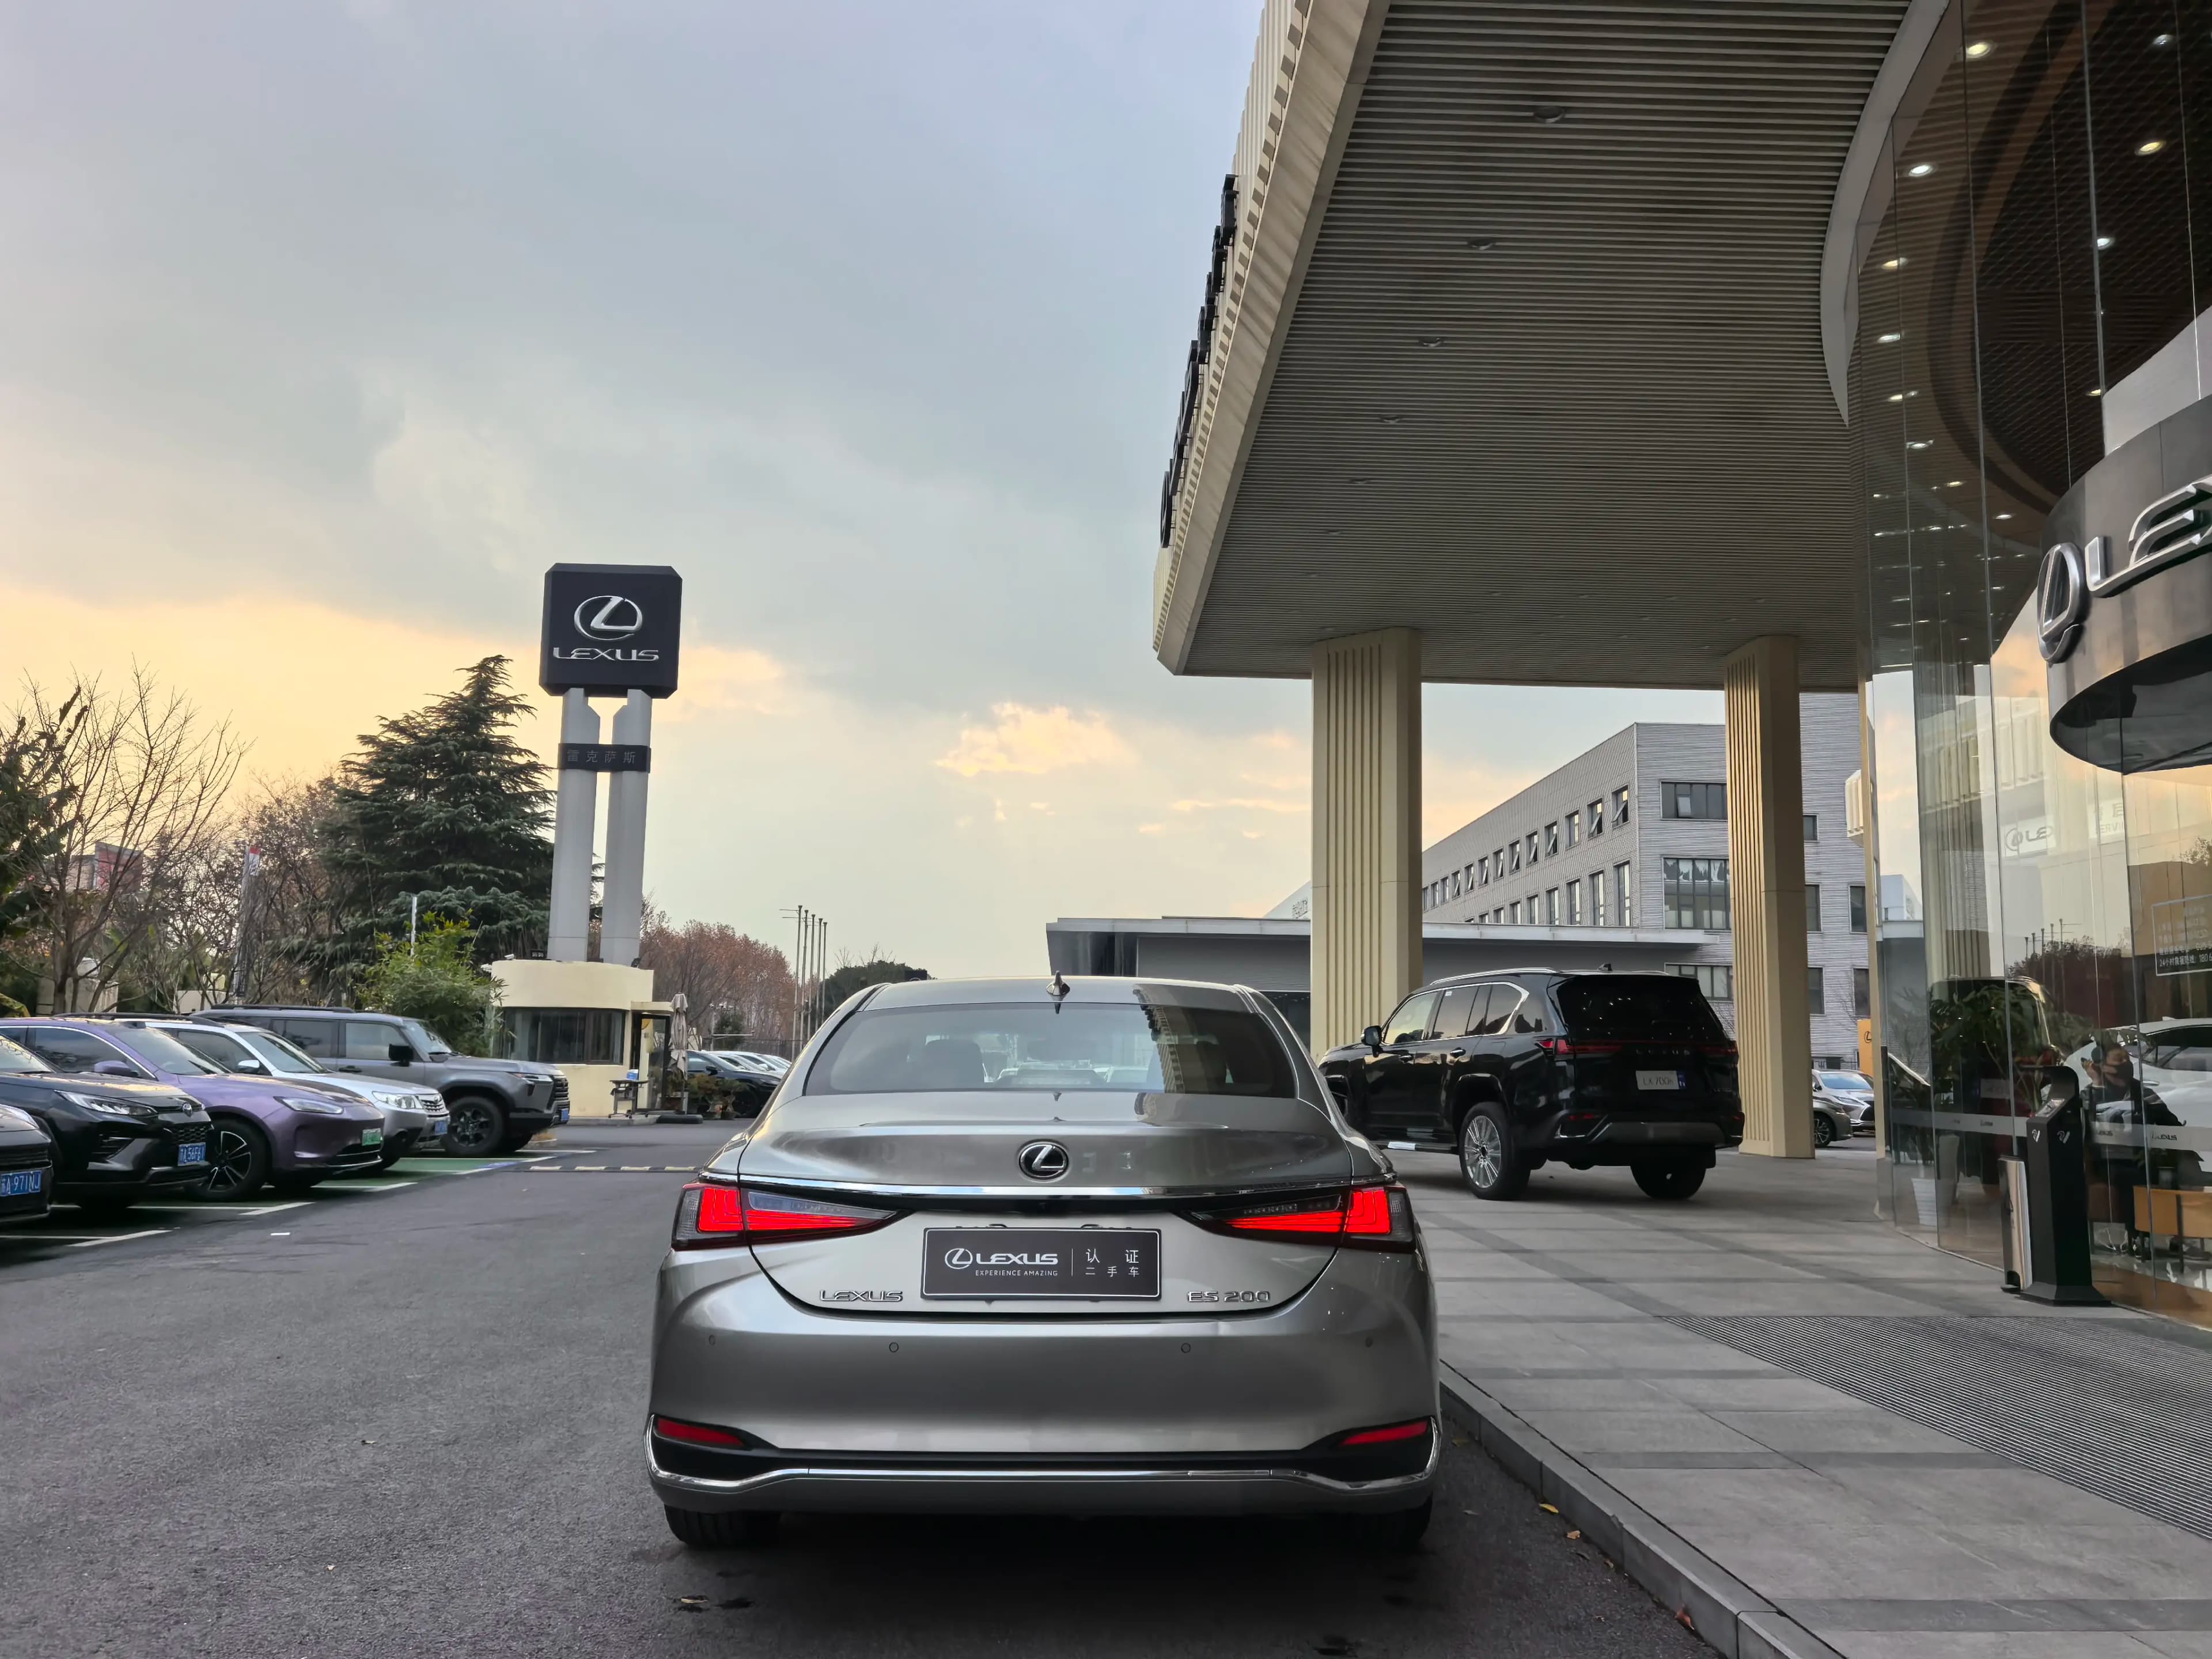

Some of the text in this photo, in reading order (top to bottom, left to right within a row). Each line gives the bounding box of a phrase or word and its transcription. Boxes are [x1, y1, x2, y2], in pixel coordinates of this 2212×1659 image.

[2085, 474, 2212, 597] LE
[553, 646, 660, 661] LEXUS
[567, 749, 637, 764] 雷克萨斯
[976, 1252, 1059, 1265] LEXUS
[1085, 1248, 1140, 1264] 认证
[1085, 1265, 1140, 1278] 二手车
[819, 1290, 903, 1302] LEXUS
[1187, 1291, 1271, 1302] ES 200
